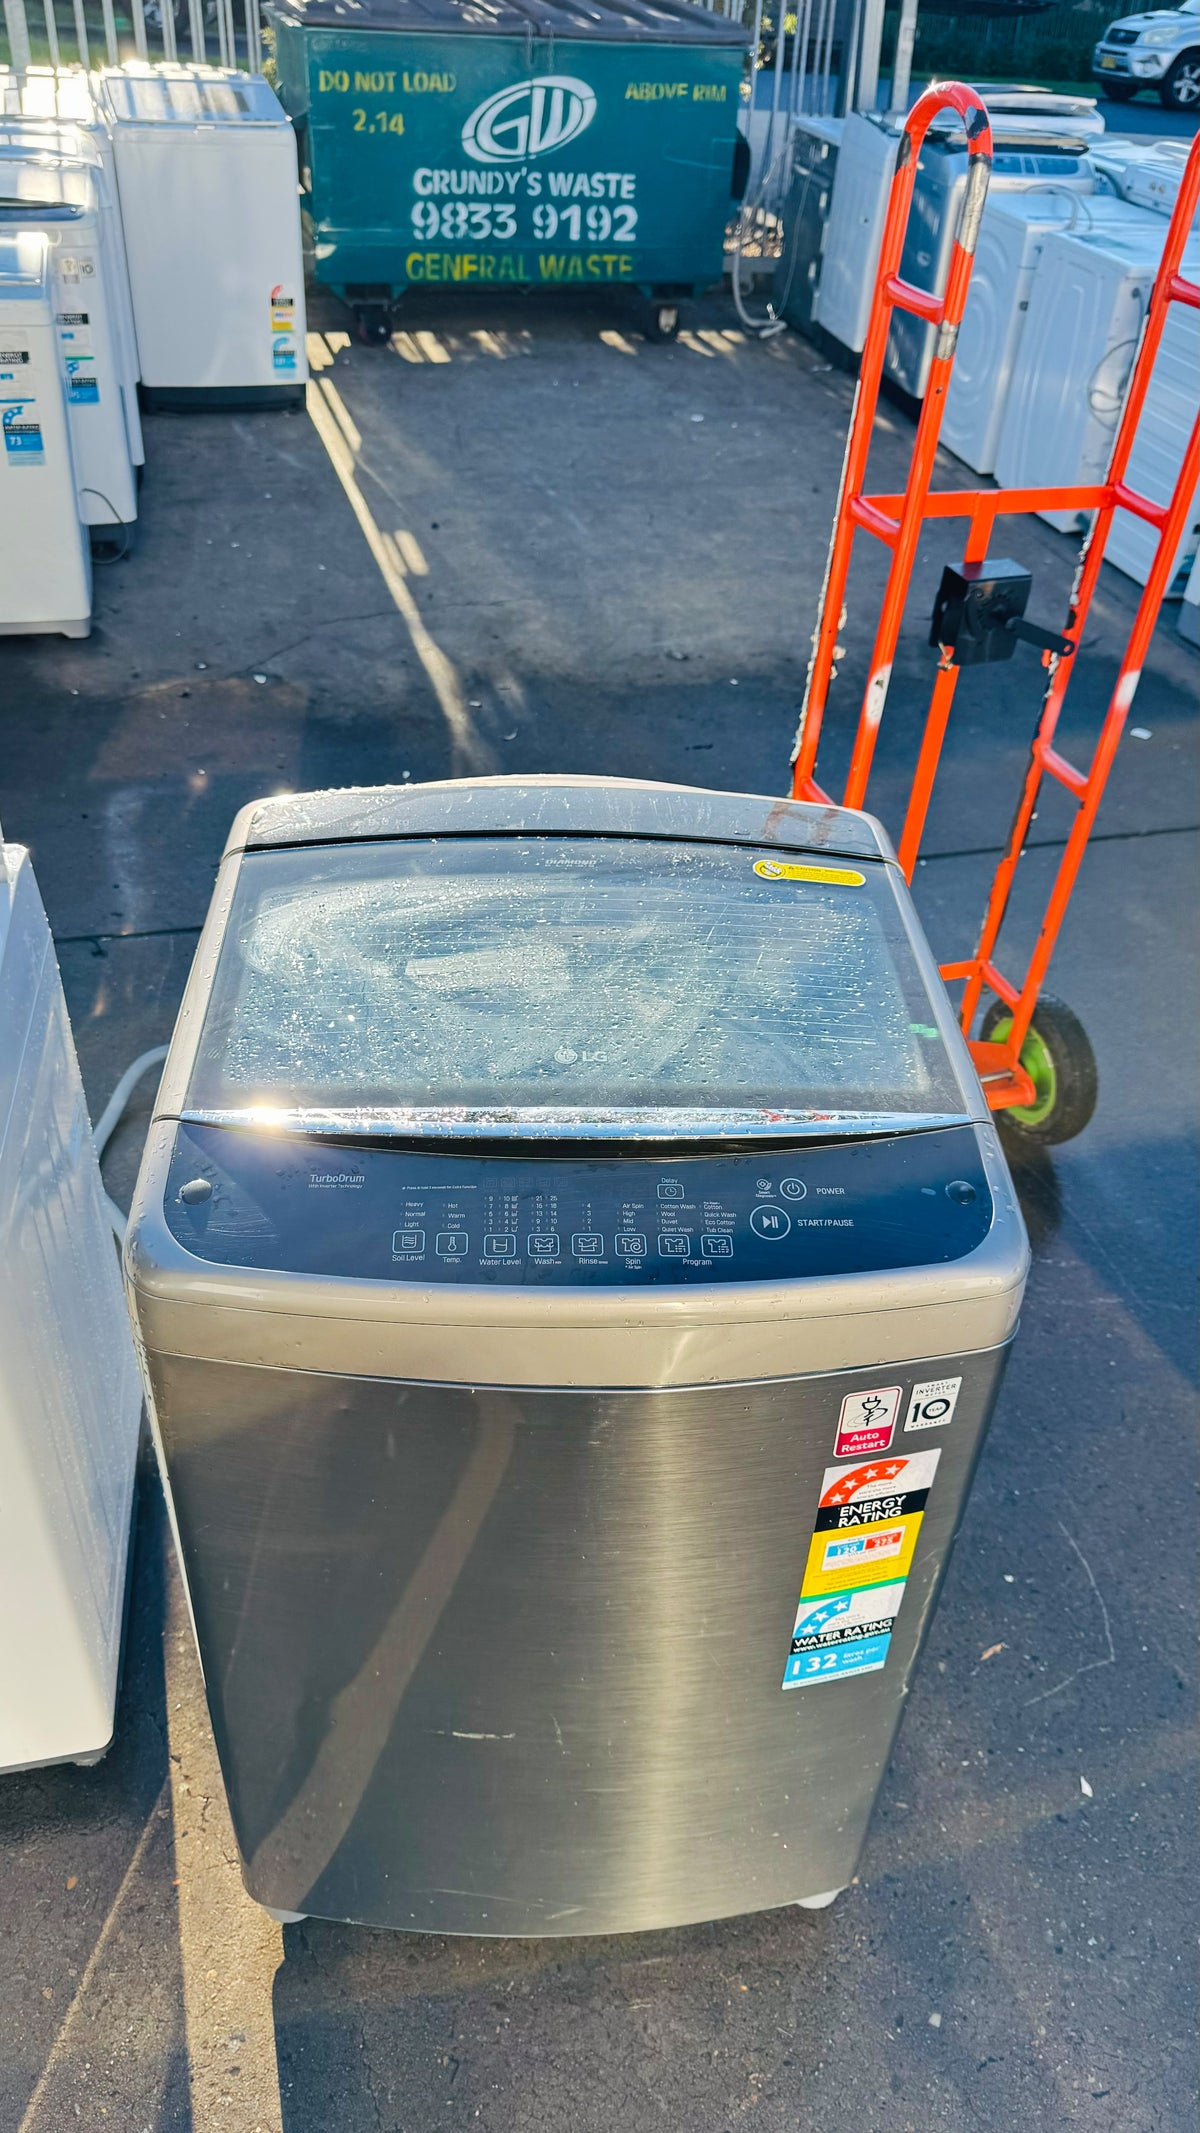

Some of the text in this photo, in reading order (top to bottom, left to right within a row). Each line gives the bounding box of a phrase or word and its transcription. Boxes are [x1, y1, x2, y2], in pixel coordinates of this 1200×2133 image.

[319, 70, 456, 92] DO NOT LOAD
[692, 84, 726, 102] RIM
[413, 166, 636, 199] GRUNDY'S WASTE
[411, 201, 638, 242] 9833 9192
[406, 252, 634, 281] GENERAL WASTE
[582, 1050, 608, 1062] LG
[310, 1174, 365, 1183] TurboDrum
[916, 1384, 957, 1395] INVERTER
[912, 1398, 950, 1423] 10
[841, 1440, 886, 1452] Restart
[850, 1432, 879, 1442] Auto
[840, 1495, 906, 1517] ENERGY
[838, 1507, 902, 1527] RATING
[837, 1546, 857, 1555] 120
[794, 1628, 890, 1653] www.waterrating.gov.au
[795, 1631, 840, 1647] WATER
[844, 1619, 892, 1636] RATING
[792, 1653, 837, 1675] 132
[842, 1656, 863, 1664] wash
[843, 1650, 864, 1659] litres
